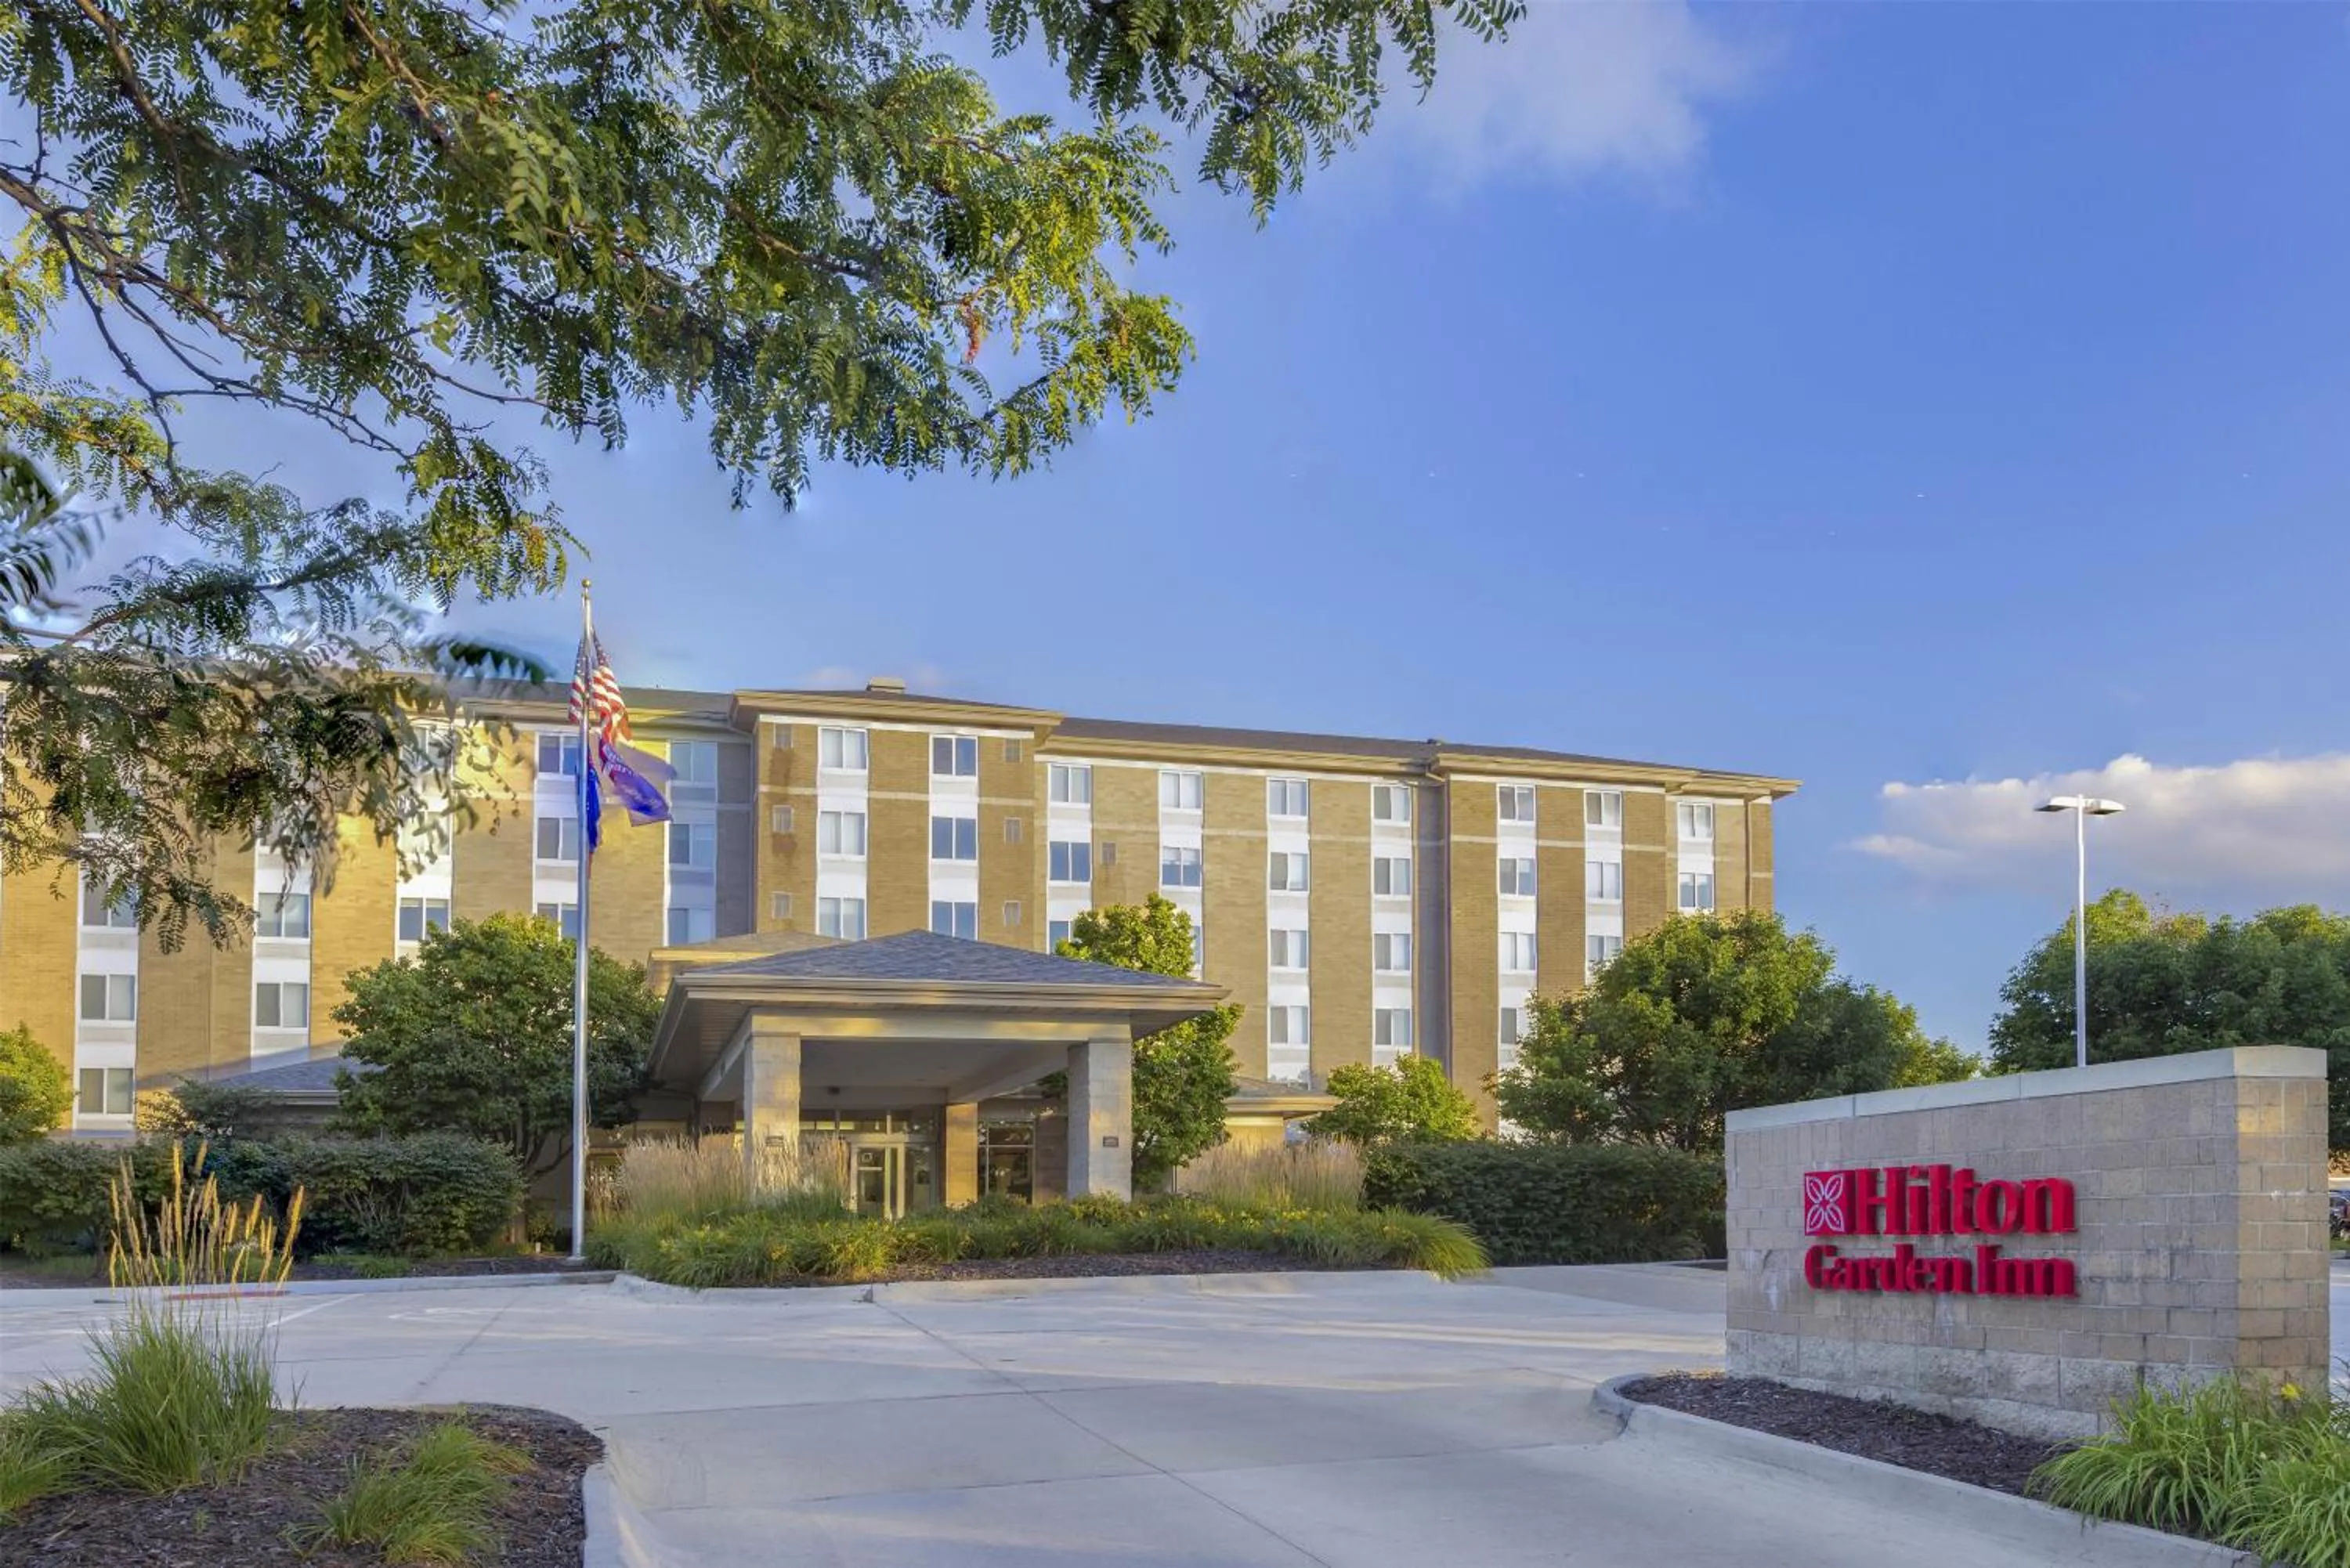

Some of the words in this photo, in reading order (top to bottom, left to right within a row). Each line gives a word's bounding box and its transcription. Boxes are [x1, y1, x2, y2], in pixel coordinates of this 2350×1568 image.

[1855, 1165, 2077, 1235] Hilton
[1805, 1243, 1973, 1293] Garden
[1976, 1244, 2078, 1297] Inn
